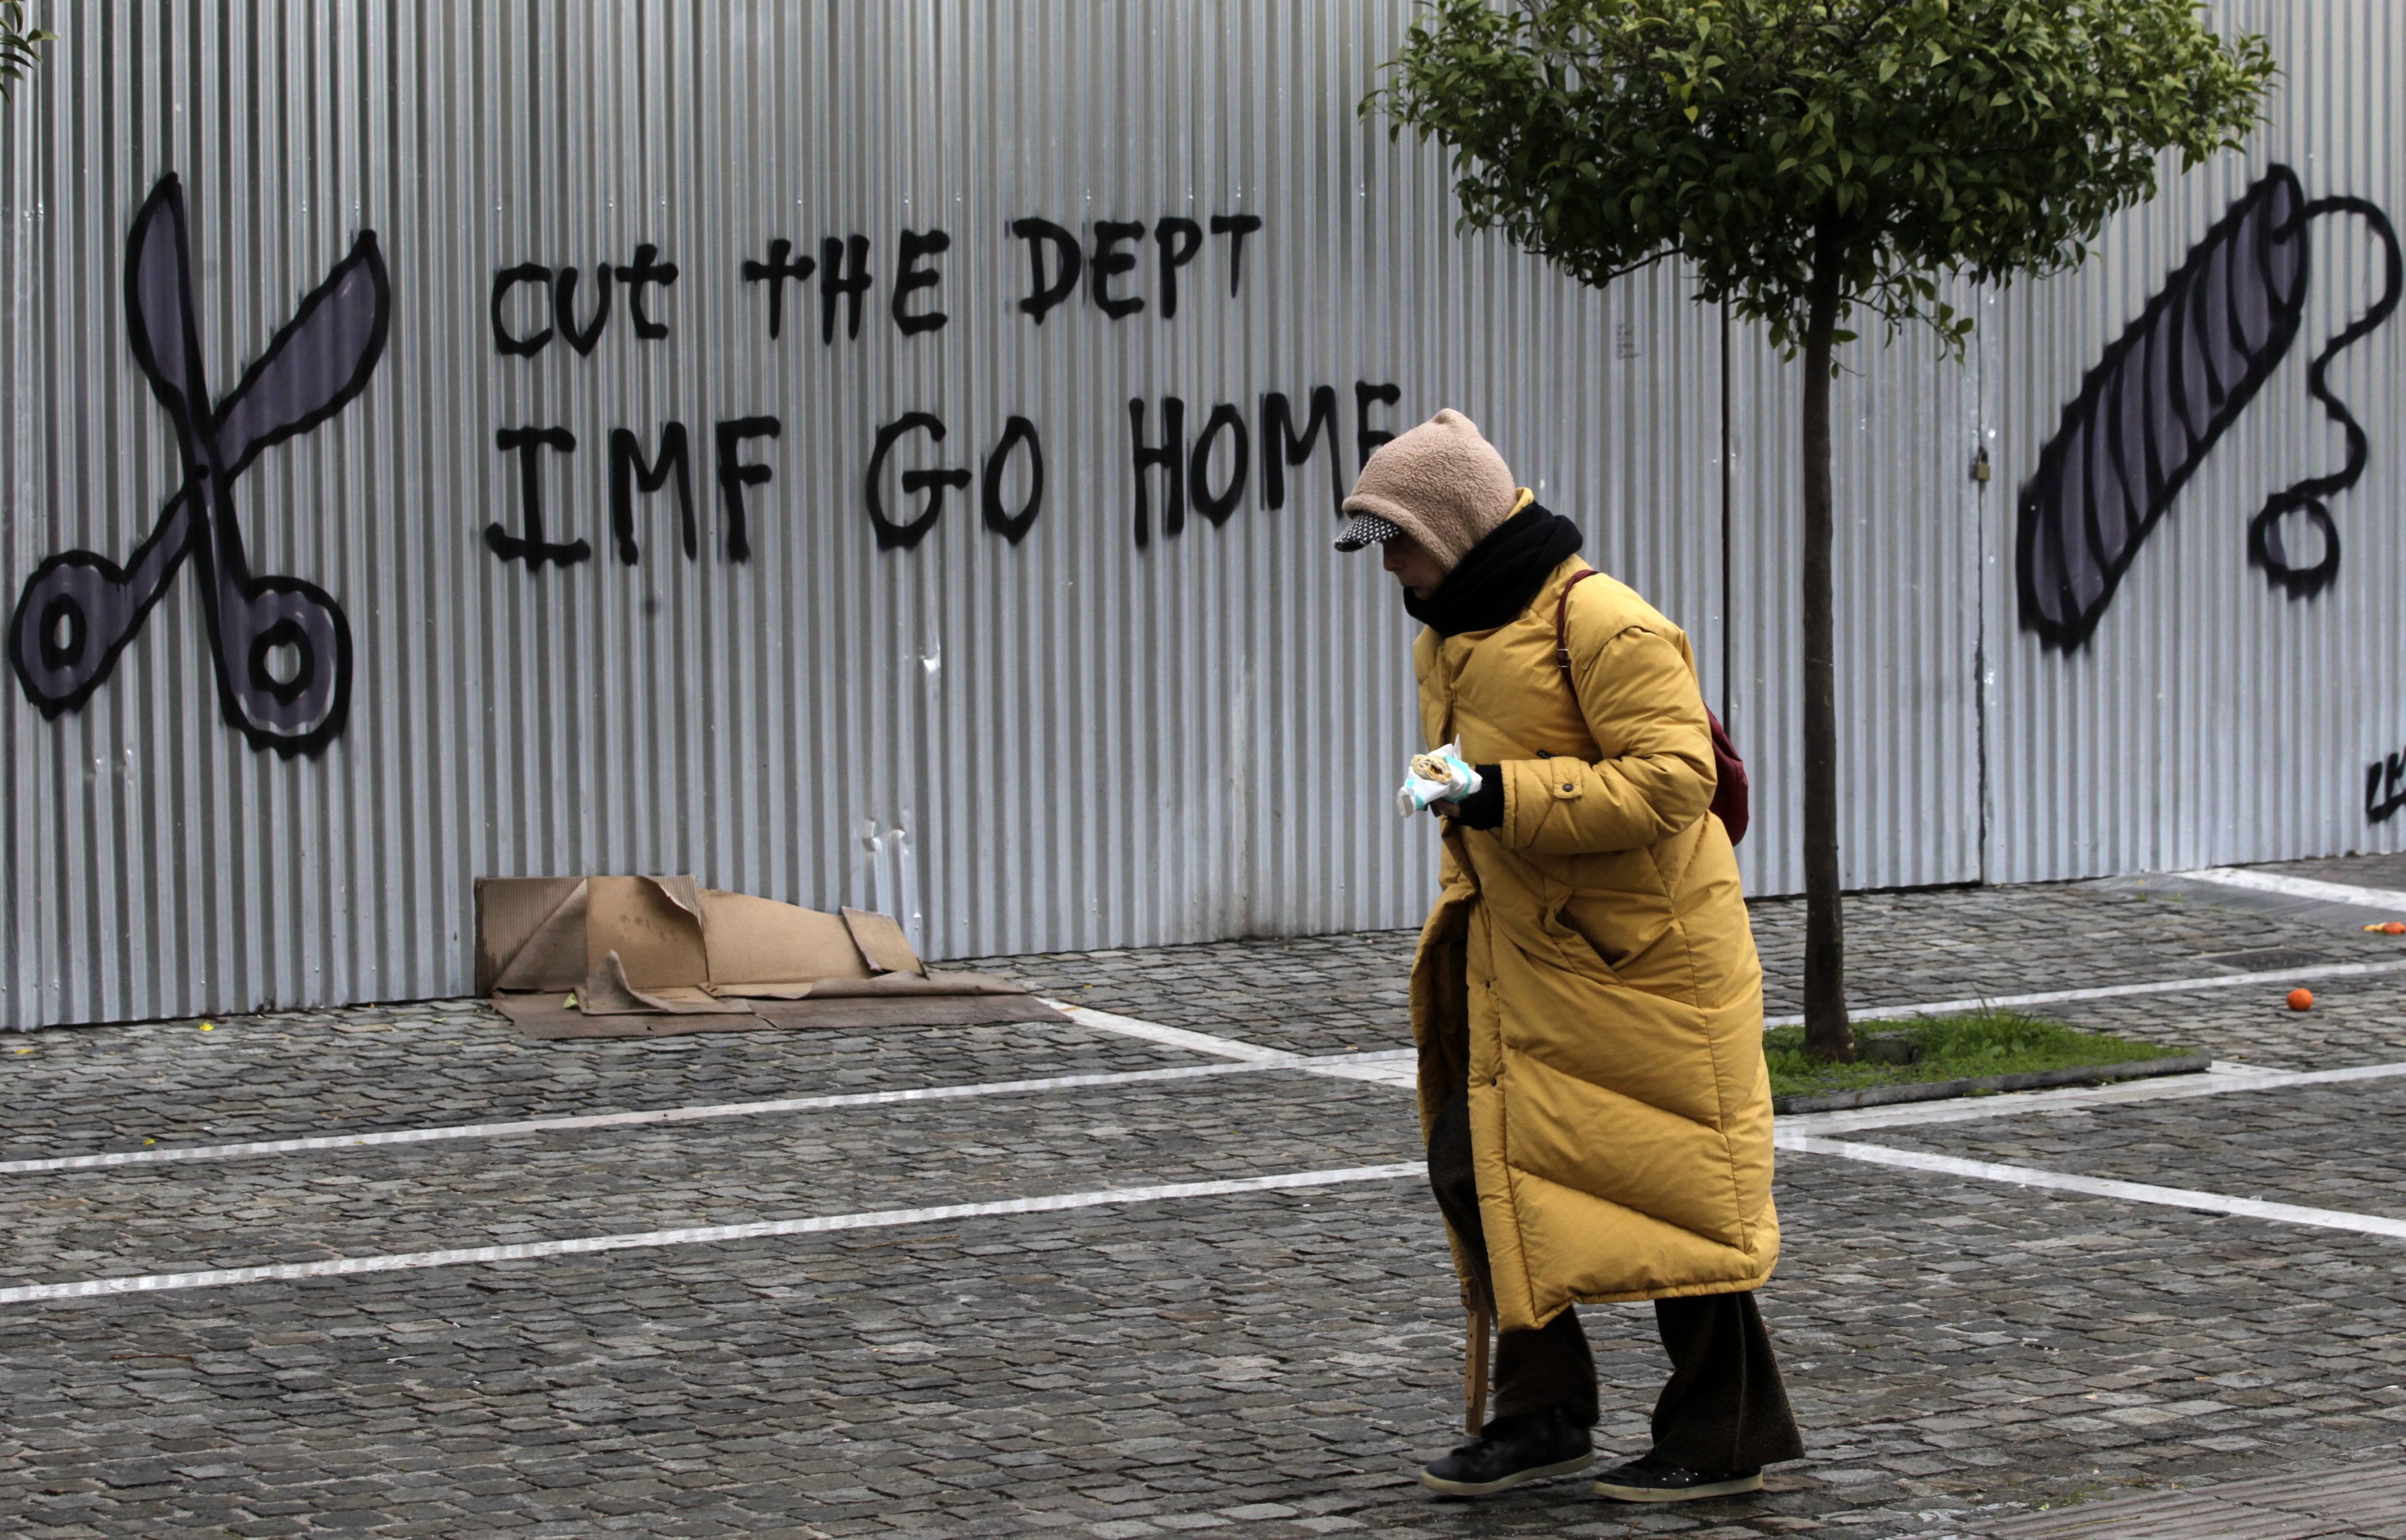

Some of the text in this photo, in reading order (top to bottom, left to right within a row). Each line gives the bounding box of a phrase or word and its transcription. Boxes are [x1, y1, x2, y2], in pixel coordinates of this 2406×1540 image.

[1012, 214, 1261, 325] DEPT
[483, 416, 781, 576] IMF
[865, 412, 1044, 552] GO
